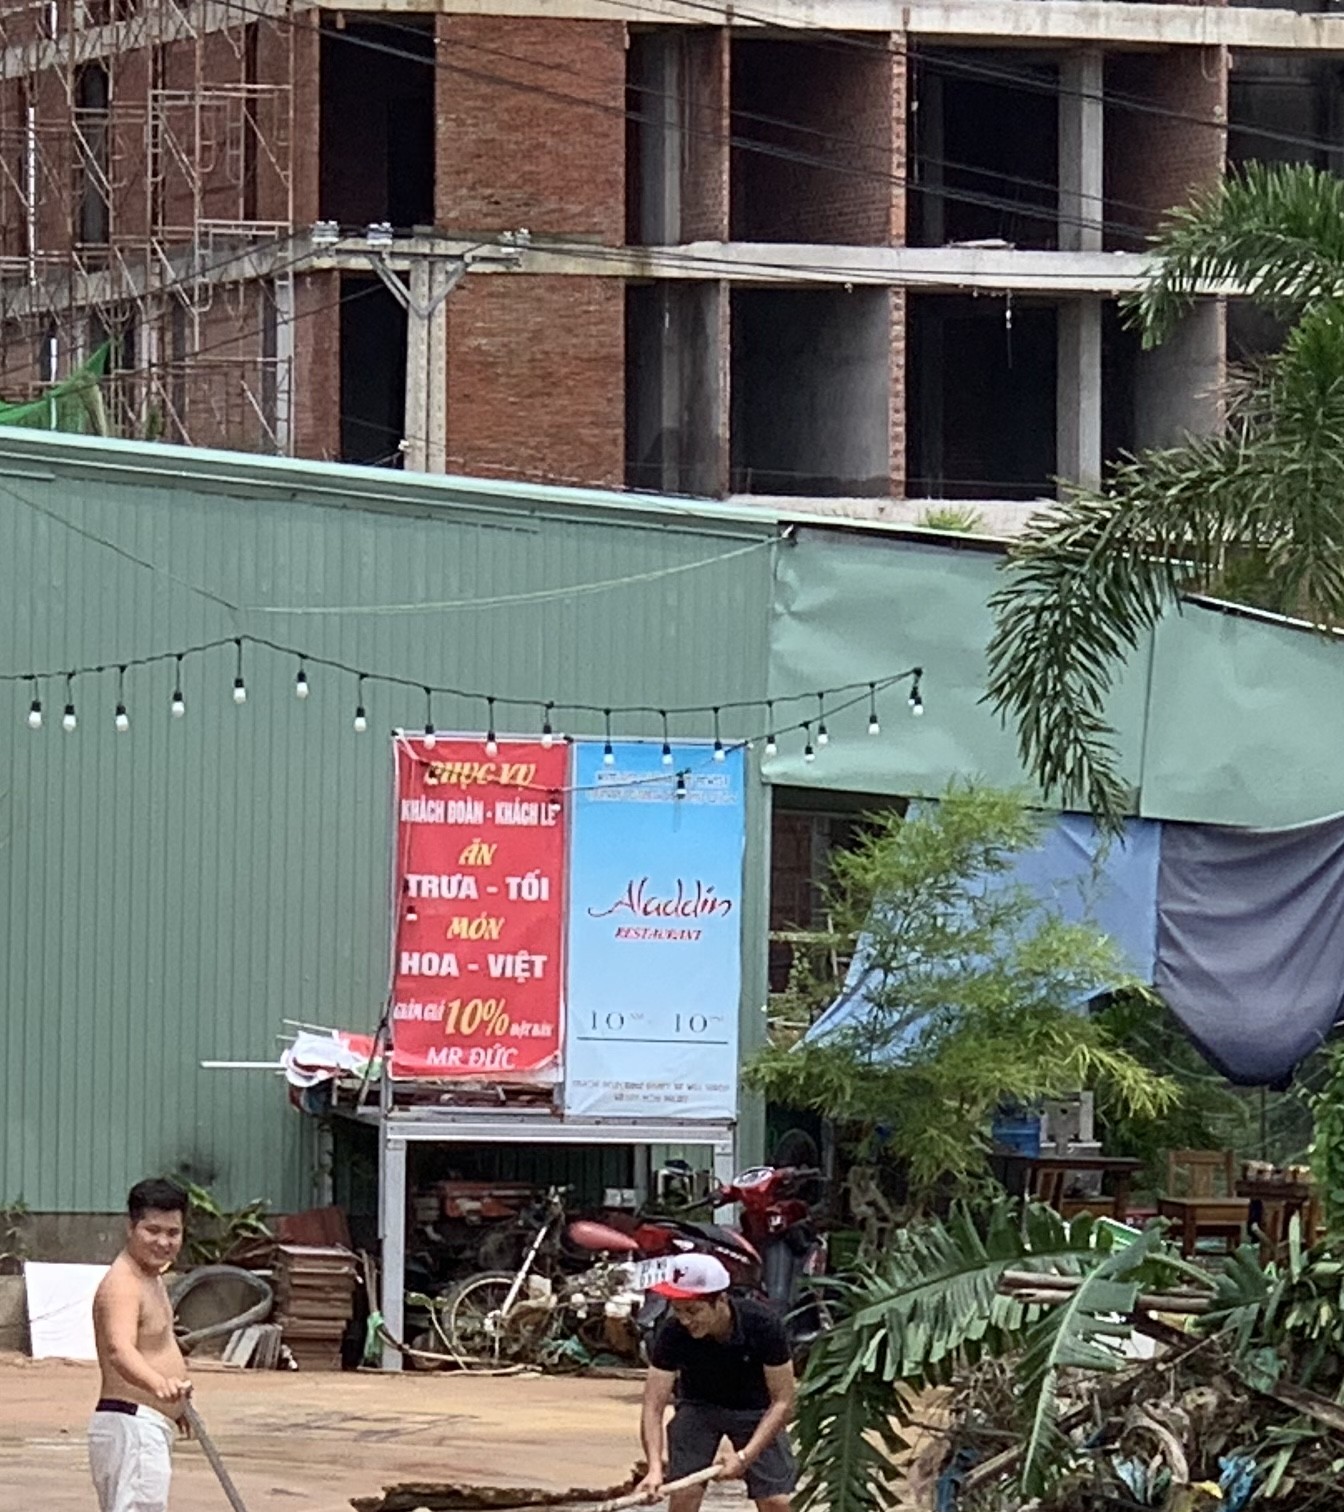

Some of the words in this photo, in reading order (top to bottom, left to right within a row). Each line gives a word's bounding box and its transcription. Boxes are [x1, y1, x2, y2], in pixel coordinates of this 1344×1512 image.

[406, 873, 479, 900] TRƯA
[505, 869, 550, 901] TỐI
[587, 876, 732, 918] Aladdin
[446, 911, 505, 940] MÓN
[614, 926, 703, 942] RESTAURANT
[400, 952, 460, 977] HOA
[487, 949, 548, 983] VIỆT
[445, 997, 510, 1037] 10%
[426, 1046, 464, 1067] MR
